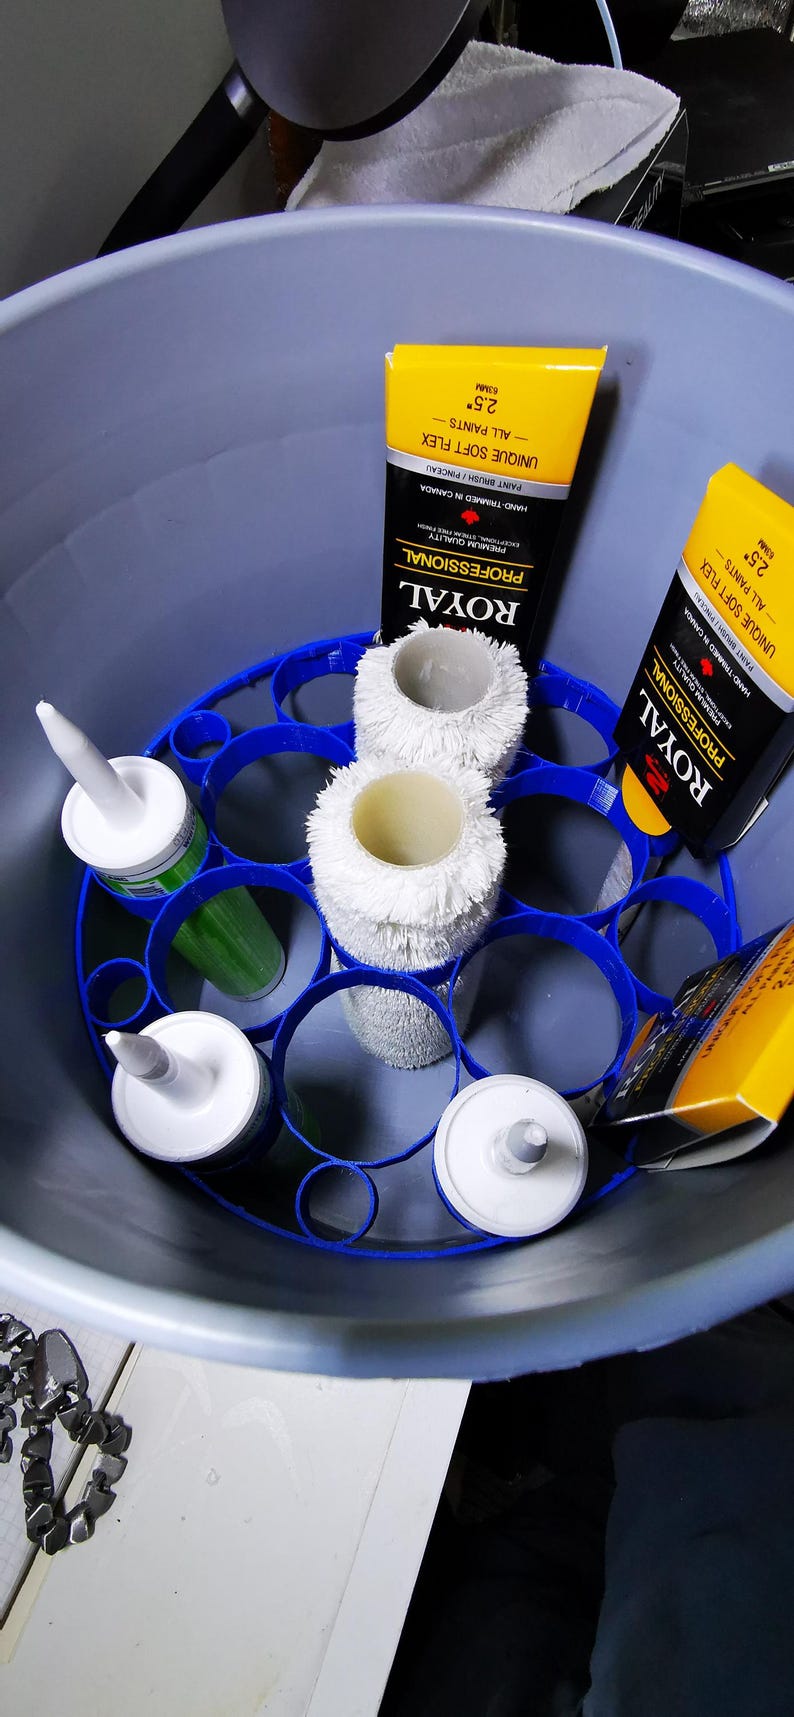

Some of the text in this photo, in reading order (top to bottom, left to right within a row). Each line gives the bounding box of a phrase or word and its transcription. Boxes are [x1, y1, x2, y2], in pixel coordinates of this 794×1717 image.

[475, 382, 498, 395] 63MM
[449, 417, 512, 440] ALL PAINTS
[421, 432, 538, 469] UNIQUE SOFT FLEX
[426, 465, 461, 480] PINCEAU
[468, 475, 496, 486] BRUSH
[497, 481, 522, 492] PAINT
[420, 483, 528, 513] HAND-TRIMMED IN CANADA
[428, 532, 506, 554] PREMIUM QUALITY
[453, 529, 477, 540] STREAK
[757, 538, 775, 560] 63MM
[402, 547, 524, 584] PROFESSIONAL
[724, 558, 766, 611] ALL PAINTS
[399, 580, 520, 626] ROYAL
[693, 592, 716, 623] PINCEAU
[700, 558, 776, 659] UNIQUE SOFT FLEX
[684, 605, 751, 698] HAND-TRIMMED IN CANADA
[717, 624, 737, 650] BRUSH
[735, 651, 754, 673] PAINT
[672, 659, 721, 727] PREMIUM QUALITY
[652, 657, 726, 769] PROFESSIONAL
[639, 688, 713, 807] ROYAL
